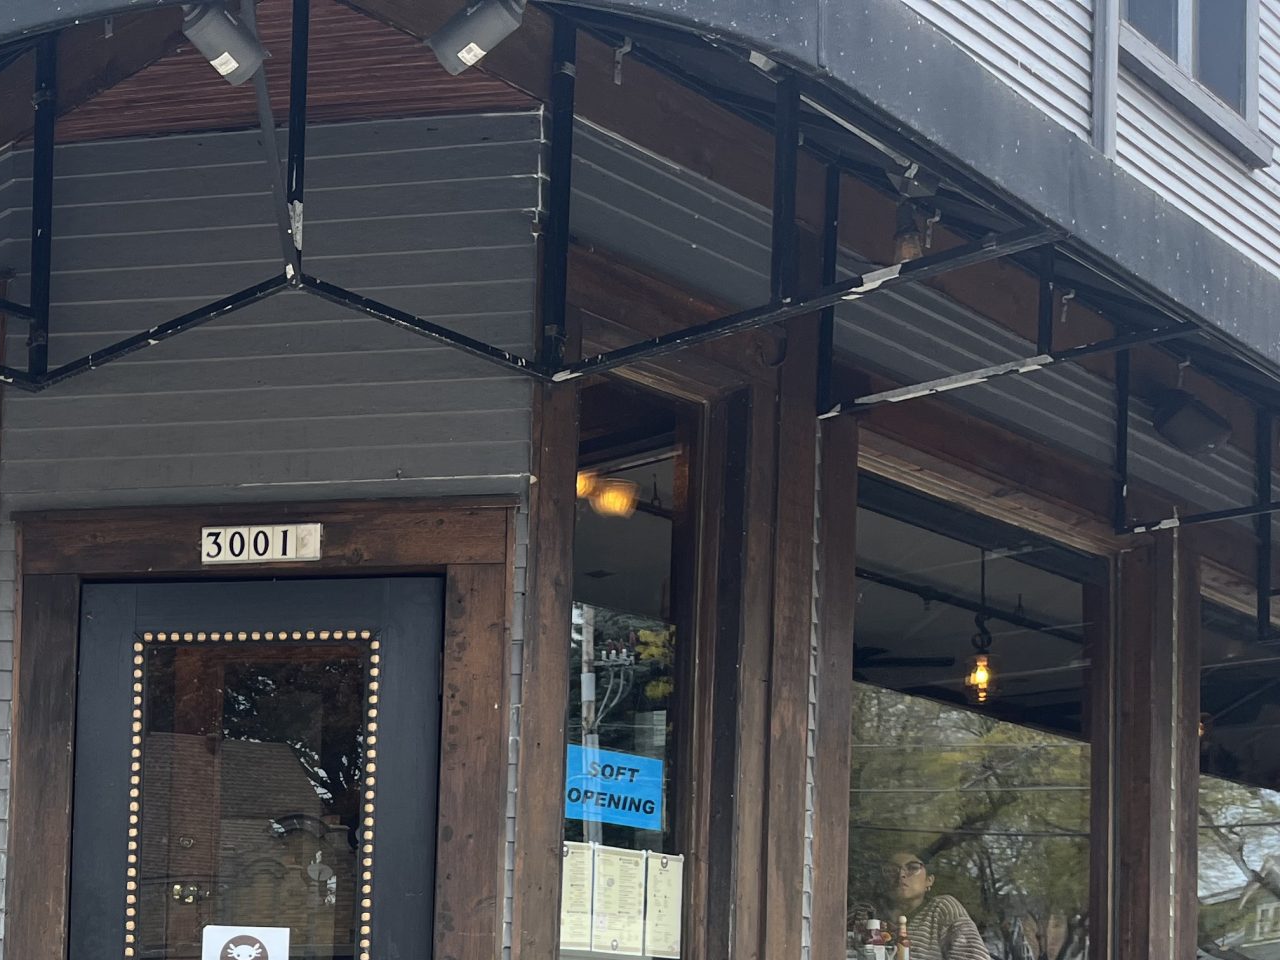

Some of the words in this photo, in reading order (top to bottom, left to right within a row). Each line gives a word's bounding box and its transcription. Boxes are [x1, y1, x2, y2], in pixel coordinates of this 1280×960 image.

[206, 529, 289, 558] 3001
[588, 761, 640, 783] SOFT
[567, 787, 656, 815] OPENING
